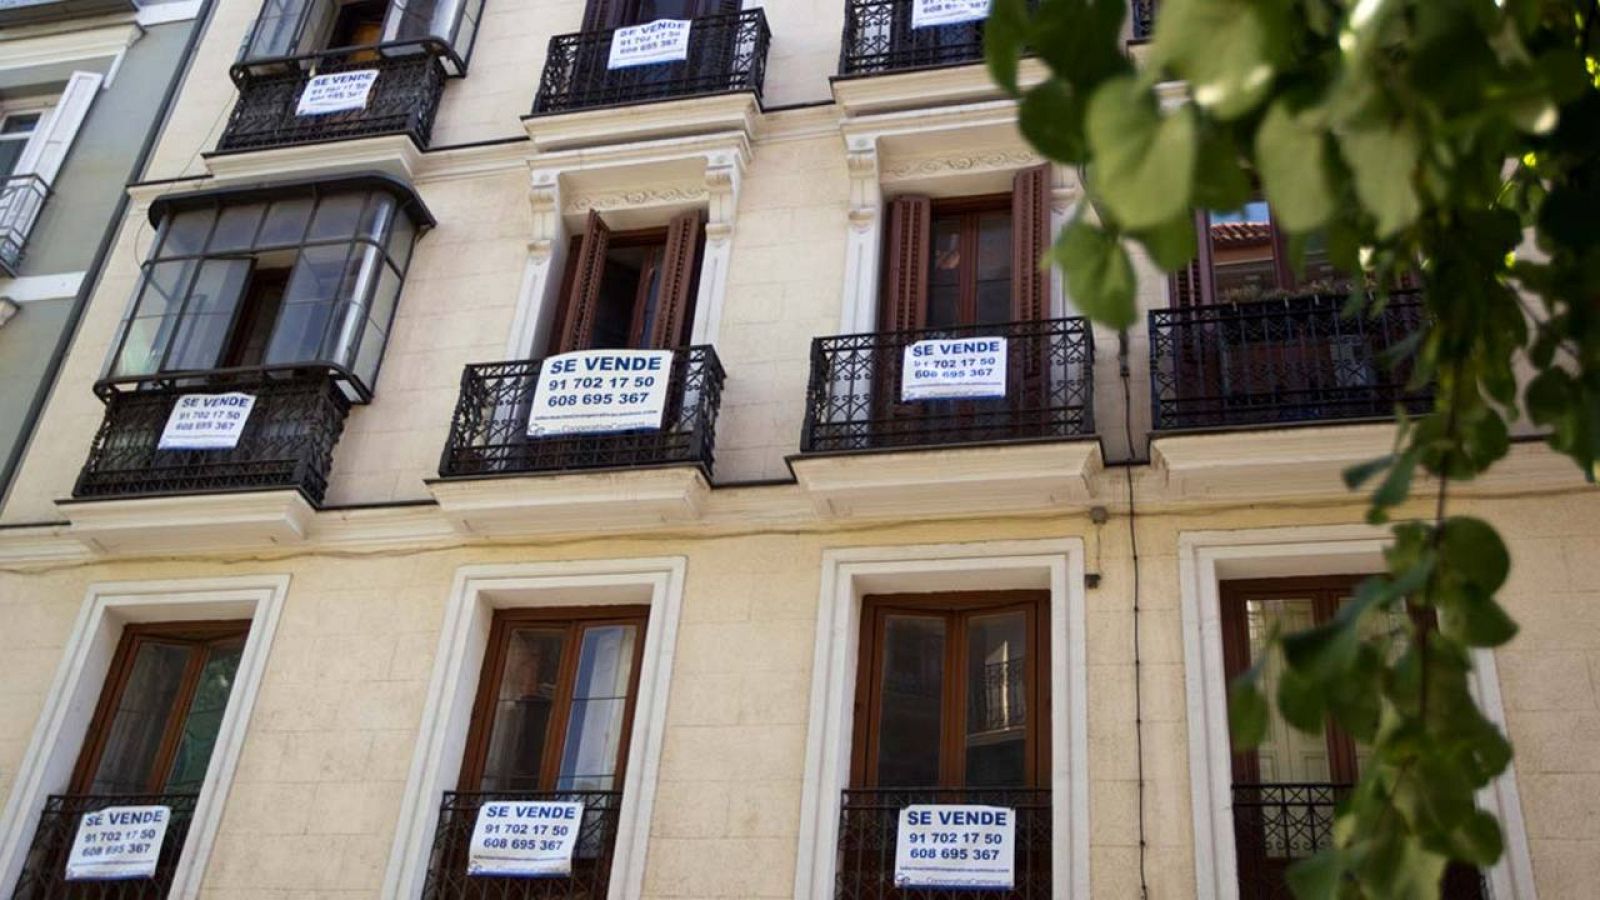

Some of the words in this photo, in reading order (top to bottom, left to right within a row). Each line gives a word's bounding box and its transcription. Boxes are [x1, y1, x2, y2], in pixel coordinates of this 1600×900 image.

[641, 22, 684, 33] VENDE
[913, 345, 934, 357] SE
[940, 341, 1000, 355] VENDE
[549, 359, 577, 374] SE
[584, 356, 662, 371] VENDE
[933, 360, 956, 369] 702
[961, 359, 976, 367] 17
[979, 357, 996, 366] 50
[969, 368, 992, 377] 367
[548, 379, 566, 390] 91
[573, 377, 603, 389] 702
[609, 377, 629, 388] 17
[634, 376, 655, 387] 50
[182, 398, 199, 408] SE
[204, 397, 250, 408] VENDE
[548, 394, 577, 407] 608
[582, 393, 613, 405] 695
[618, 392, 649, 404] 367
[227, 411, 241, 420] 50
[214, 421, 235, 430] 367
[86, 814, 104, 826] SE
[109, 810, 164, 825] VENDE
[485, 806, 510, 818] SE
[516, 806, 577, 819] VENDE
[907, 811, 931, 825] SE
[939, 811, 1008, 826] VENDE
[85, 833, 97, 843] 91
[100, 831, 122, 842] 702
[140, 829, 156, 840] 50
[484, 824, 500, 834] 91
[504, 824, 528, 835] 702
[533, 824, 548, 835] 17
[552, 825, 569, 836] 50
[483, 838, 508, 849] 608
[511, 839, 536, 850] 695
[539, 840, 563, 851] 367
[909, 832, 926, 843] 91
[931, 832, 957, 843] 702
[962, 832, 980, 843] 17
[984, 833, 1002, 844] 50
[127, 843, 151, 854] 367
[910, 848, 936, 859] 608
[941, 848, 968, 860] 695
[972, 849, 1000, 861] 367
